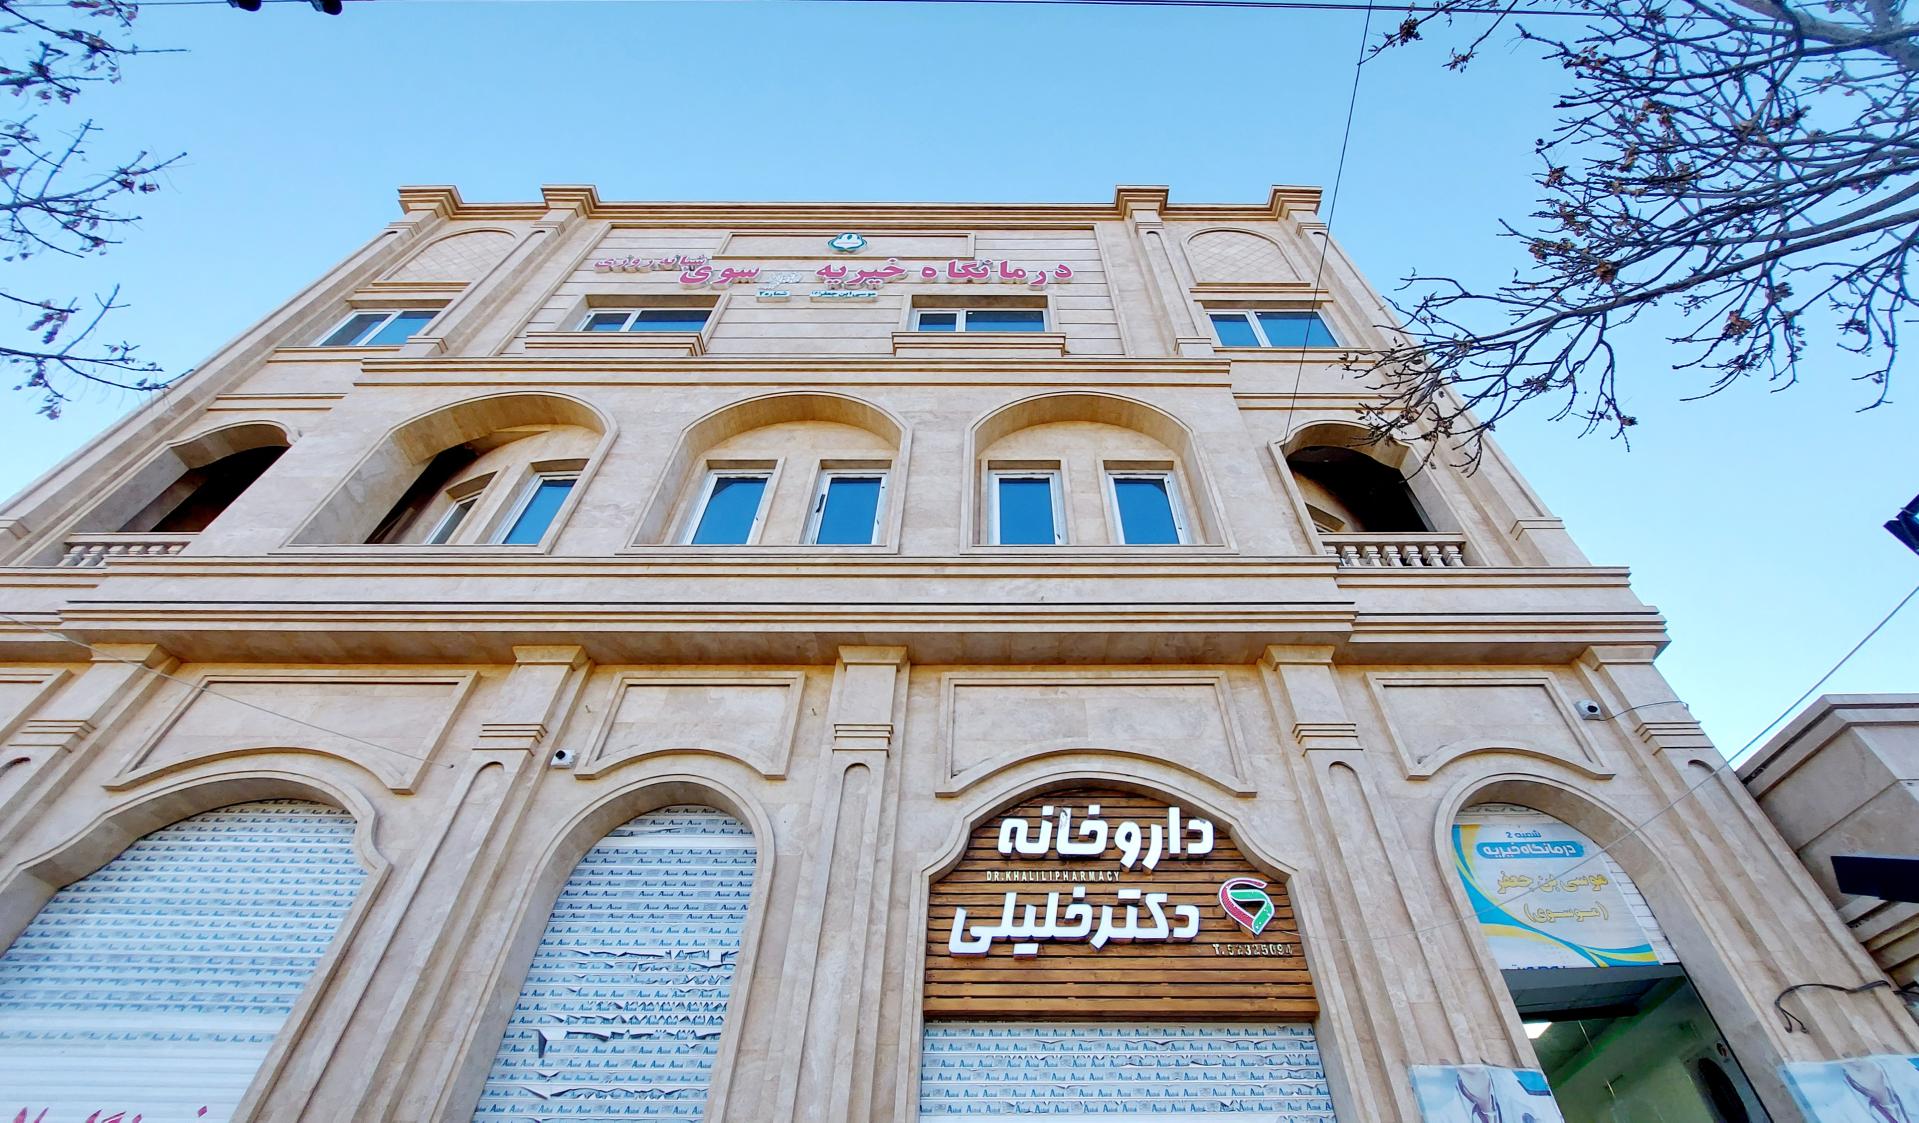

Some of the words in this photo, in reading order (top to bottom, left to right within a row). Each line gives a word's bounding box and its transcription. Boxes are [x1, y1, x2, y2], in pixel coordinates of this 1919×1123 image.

[816, 258, 907, 286] خیریه
[998, 804, 1216, 868] داروخانه
[1560, 873, 1609, 892] موسی
[948, 886, 1092, 957] خلیلی
[1090, 888, 1200, 949] دکتر
